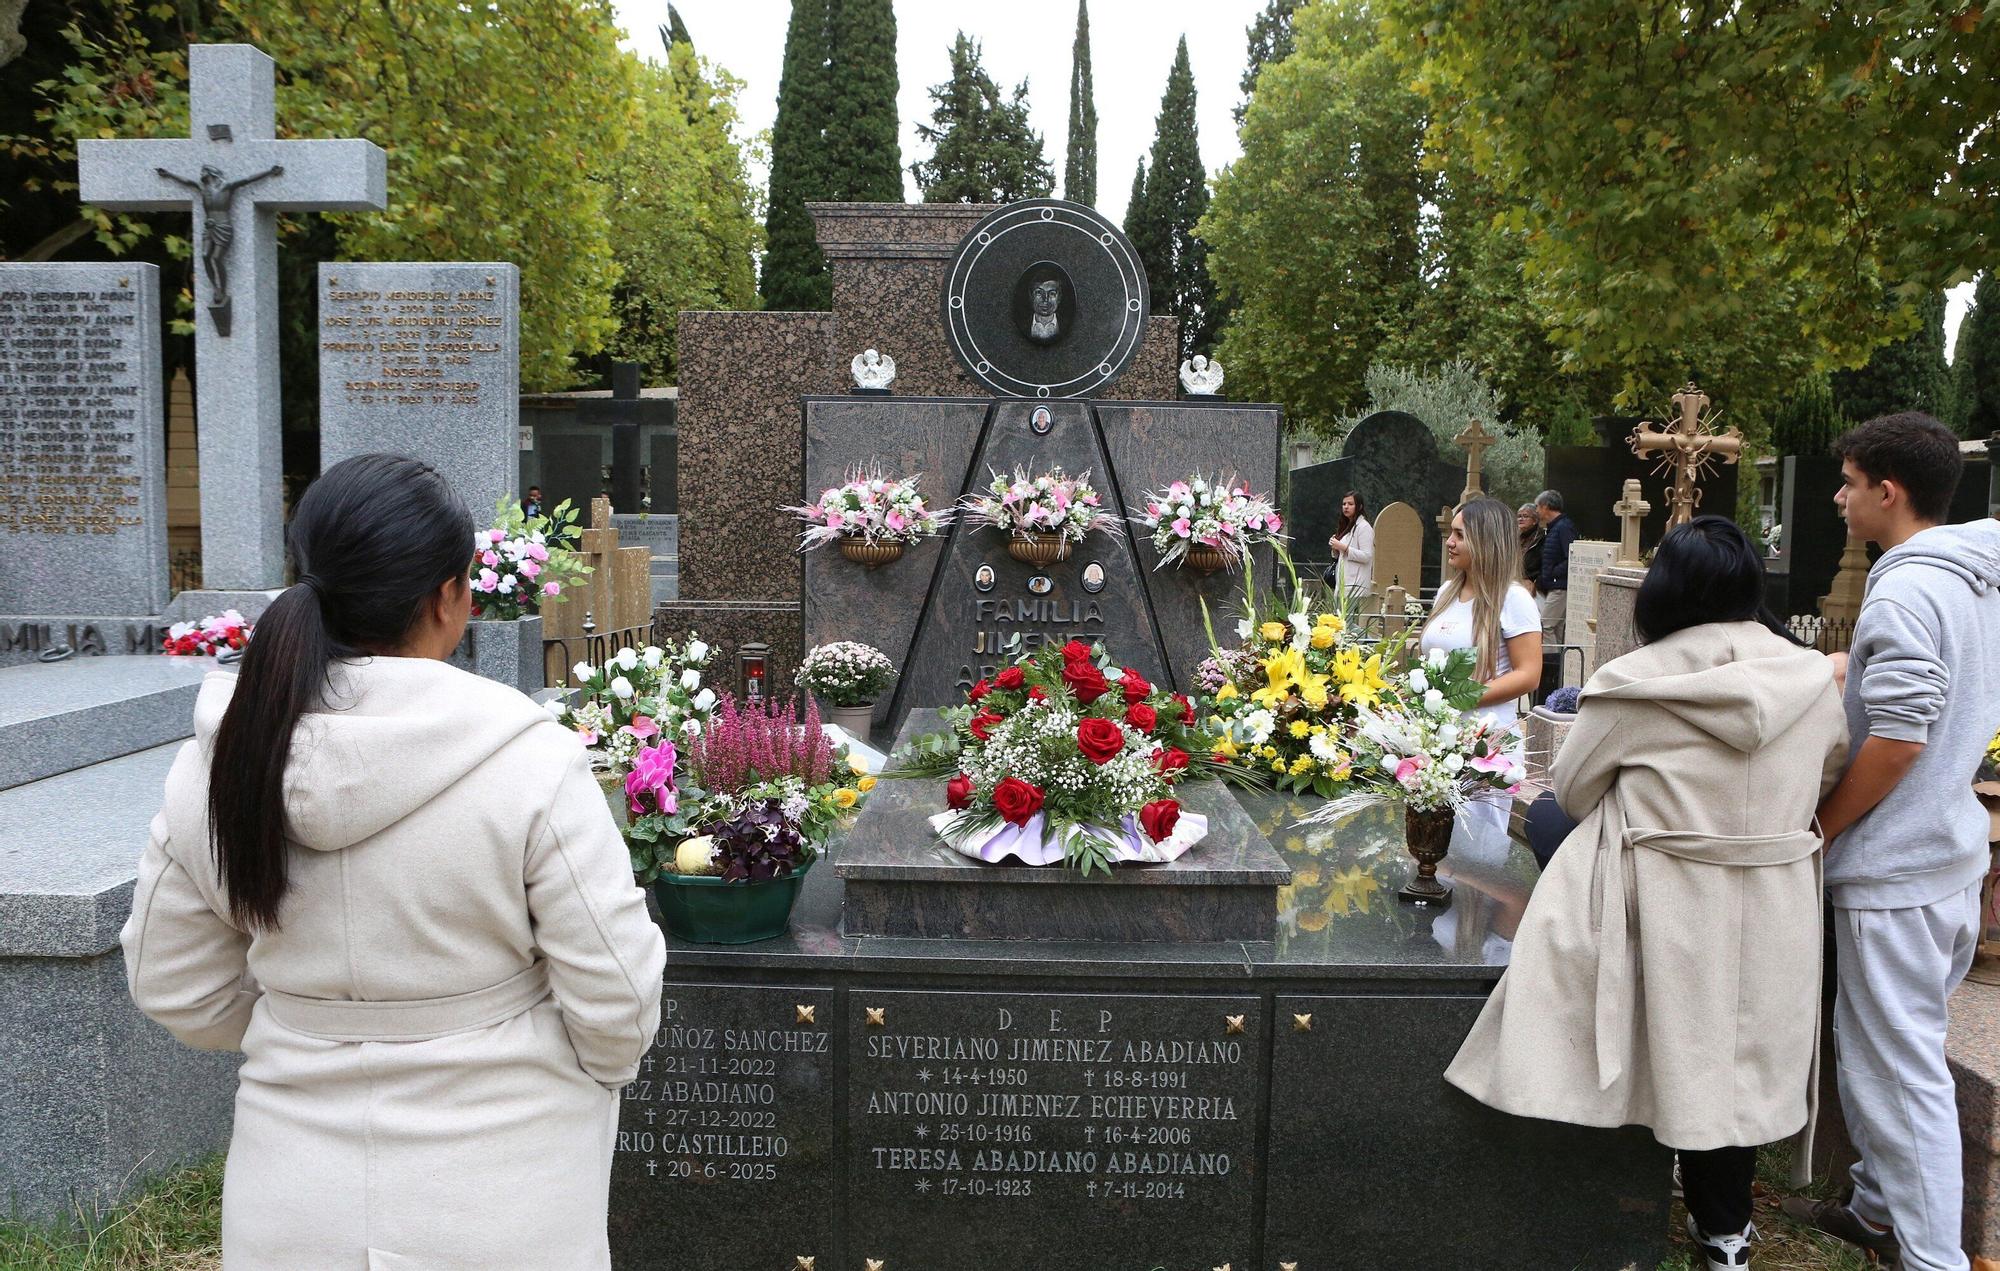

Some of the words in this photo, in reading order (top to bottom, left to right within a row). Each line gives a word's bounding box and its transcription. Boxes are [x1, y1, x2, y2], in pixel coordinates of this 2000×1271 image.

[975, 599, 1104, 623] FAMILIA
[651, 1024, 715, 1049] UÑOZ
[724, 1029, 829, 1053] SANCHEZ
[867, 1035, 999, 1060] SEVERIANO
[1008, 1038, 1112, 1063] JIMENEZ
[1123, 1040, 1241, 1064] ABADIANO
[665, 1056, 776, 1076] 21-11-2022
[942, 1067, 1028, 1086] 14-4-1950
[1104, 1070, 1187, 1089] 18-8-1991
[661, 1081, 775, 1105] ABADIANO
[867, 1091, 968, 1116] ANTONIO
[976, 1093, 1082, 1118] JIMENEZ
[1090, 1095, 1238, 1120] ECHEVERRIA
[666, 1109, 776, 1129] 27-12-2022
[939, 1123, 1032, 1142] 25-10-1916
[1104, 1126, 1192, 1145] 16-4-2006
[615, 1132, 655, 1153] RIO
[662, 1134, 788, 1158] CASTILLEJO
[668, 1160, 777, 1181] 20-6-2025
[872, 1147, 963, 1171] TERESA
[972, 1150, 1097, 1174] ABADIANO
[1105, 1152, 1231, 1176] ABADIANO
[942, 1178, 1032, 1197] 17-10-1923
[1104, 1181, 1185, 1200] 7-11-2014
